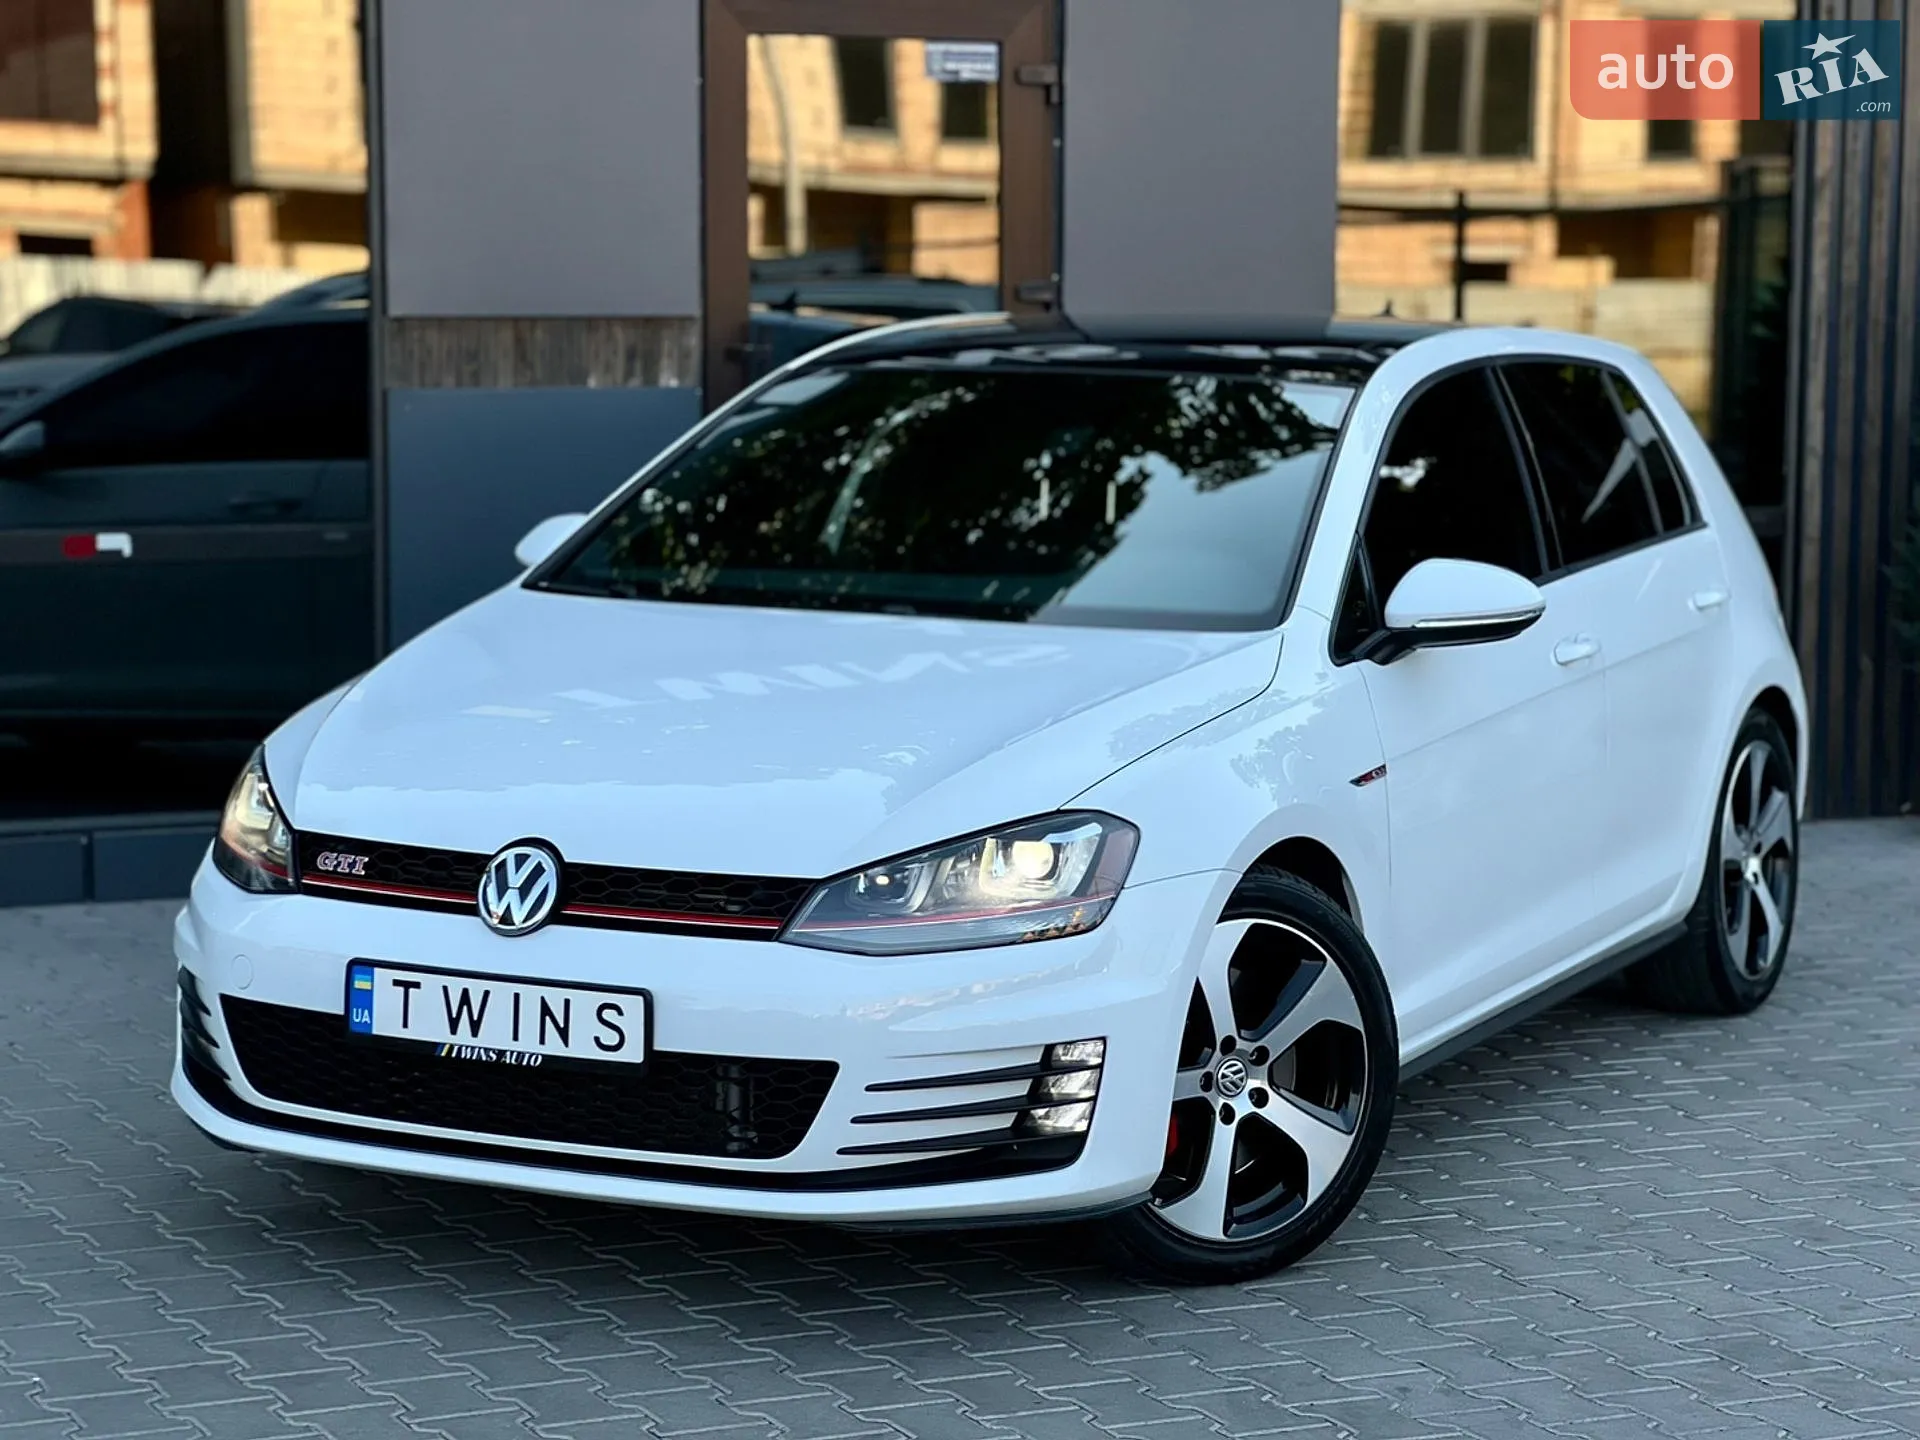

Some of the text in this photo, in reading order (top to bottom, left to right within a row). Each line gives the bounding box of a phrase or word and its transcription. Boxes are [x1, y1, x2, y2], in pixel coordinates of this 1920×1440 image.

[316, 851, 369, 876] GTI
[353, 1007, 371, 1024] UA
[392, 978, 626, 1053] TWINS
[451, 1044, 543, 1067] TWINS AUTO
